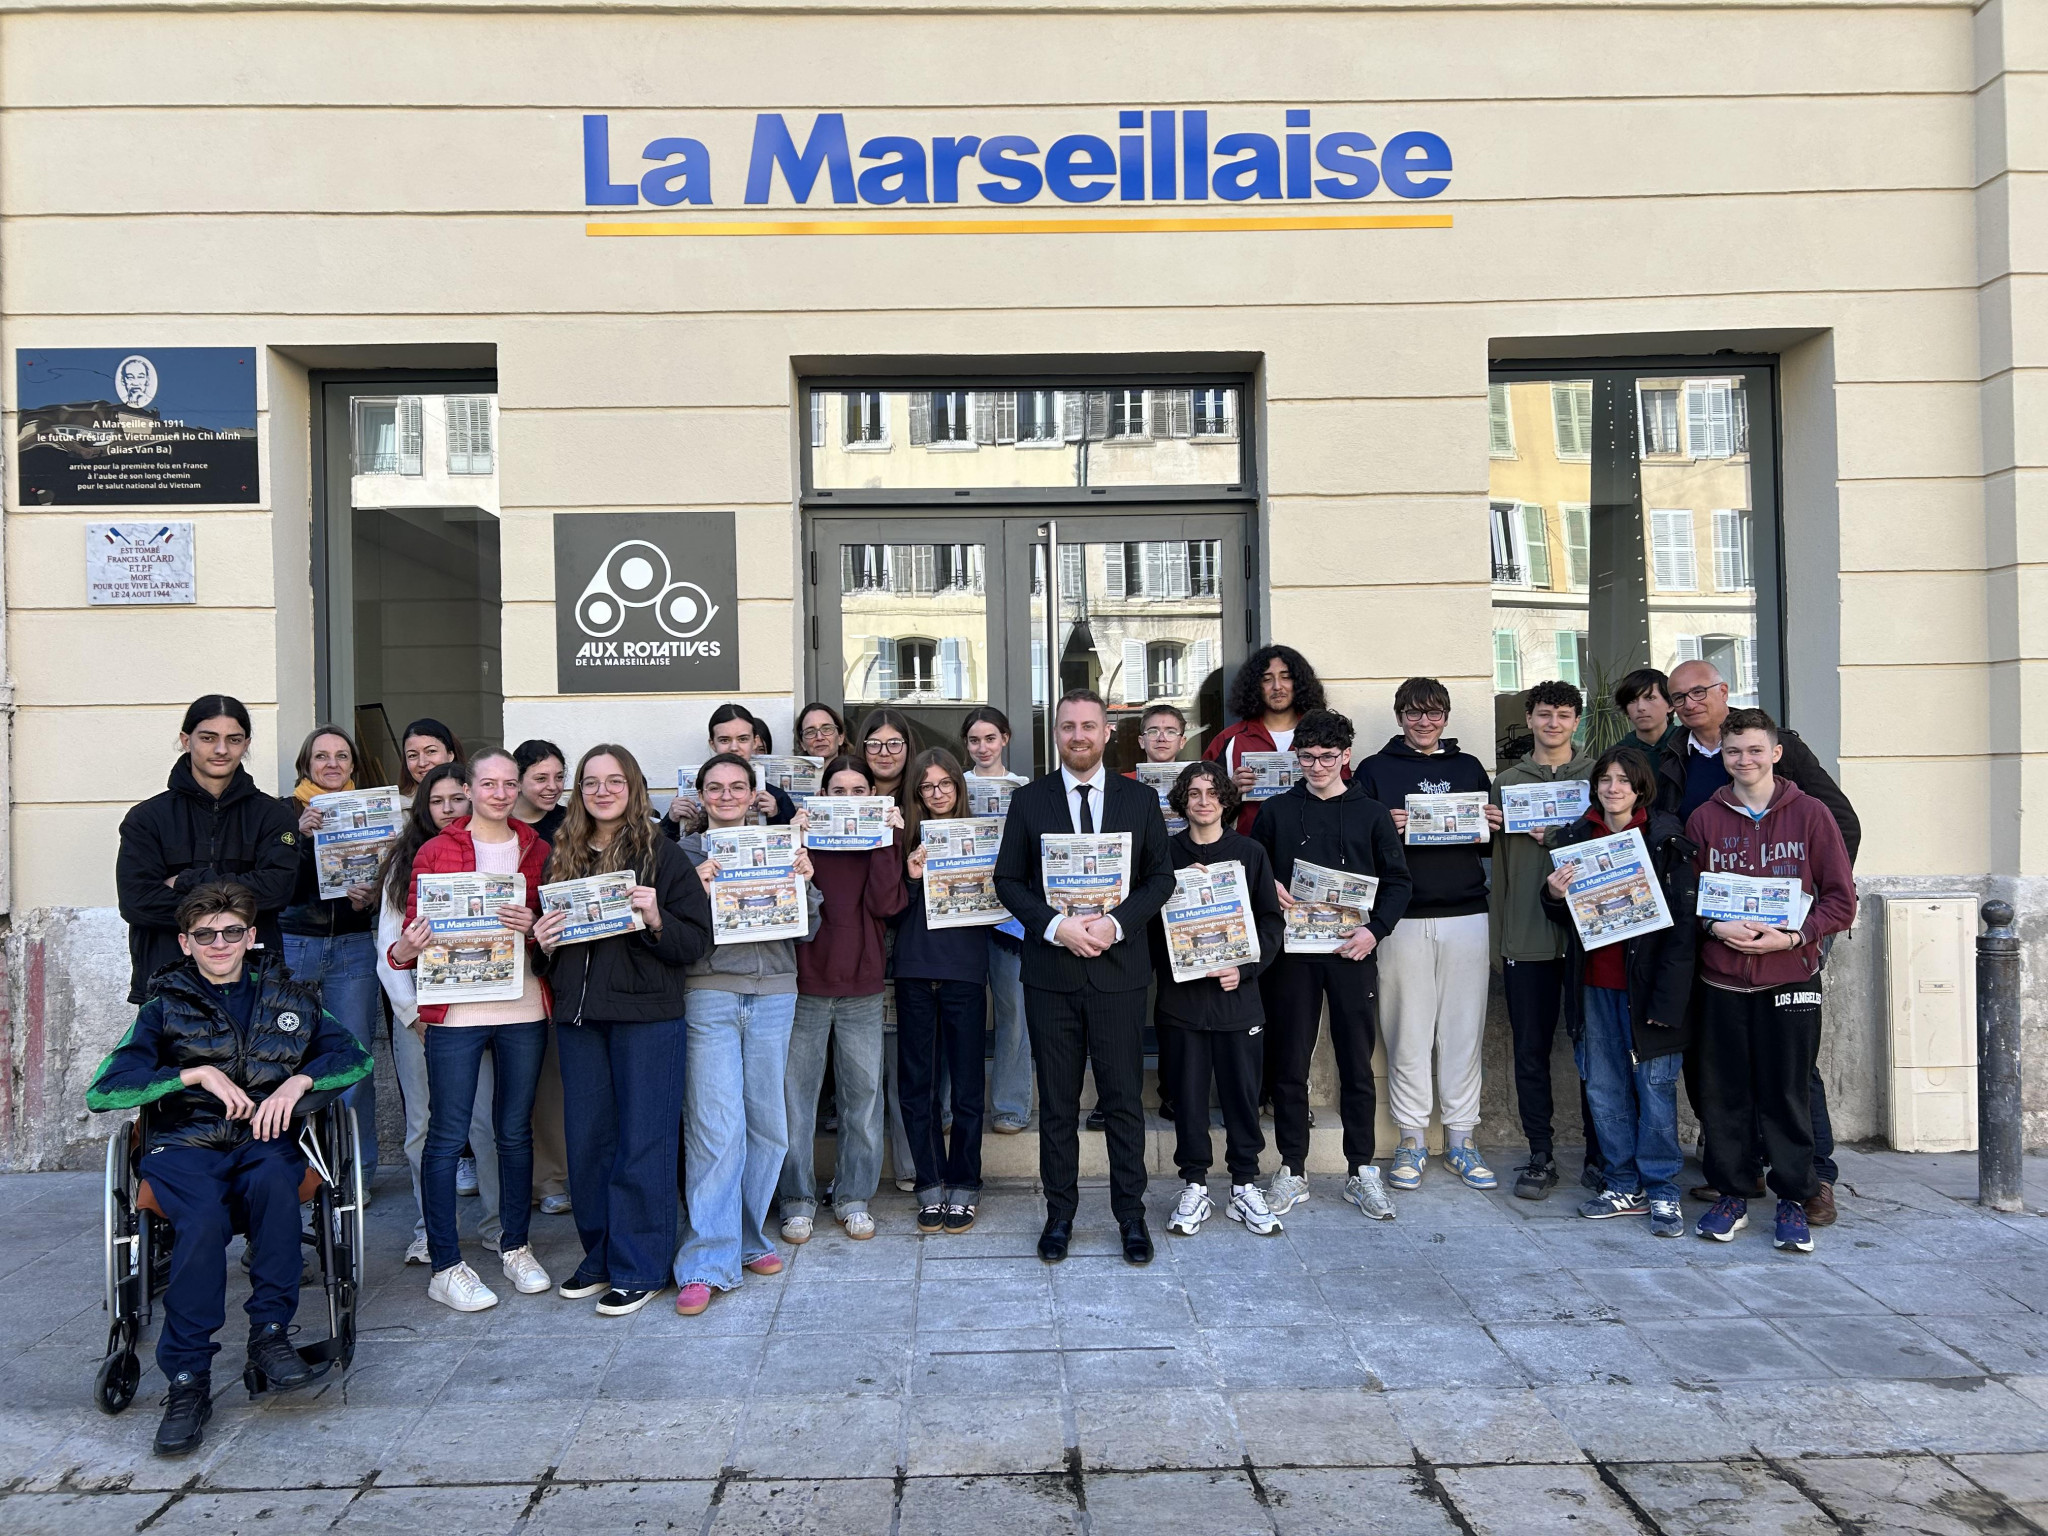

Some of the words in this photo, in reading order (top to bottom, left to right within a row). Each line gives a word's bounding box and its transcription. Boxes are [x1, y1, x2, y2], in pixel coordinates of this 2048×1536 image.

[583, 114, 713, 206] La
[744, 109, 1454, 206] Marseillaise
[92, 420, 100, 428] A
[102, 420, 146, 428] Marseille
[148, 420, 161, 428] en
[163, 420, 184, 428] 1911
[37, 433, 47, 442] le
[48, 433, 73, 442] futur
[76, 432, 122, 442] Président
[124, 432, 180, 441] Vietnamien
[182, 432, 196, 440] Ho
[198, 432, 214, 440] Chi
[216, 432, 240, 440] Minh
[106, 445, 133, 456] (alias
[135, 446, 154, 454] Van
[156, 444, 172, 455] Ba)
[92, 464, 111, 472] pour
[112, 462, 120, 470] la
[120, 462, 155, 472] première
[156, 462, 170, 470] fois
[87, 472, 92, 480] à
[94, 472, 117, 480] l'aube
[118, 472, 128, 480] de
[144, 472, 162, 480] long
[77, 483, 96, 491] pour
[96, 482, 104, 490] le
[105, 482, 124, 490] salut
[134, 546, 160, 554] TOMBÉ
[140, 554, 174, 562] AICARD
[114, 582, 130, 590] QUE
[130, 582, 148, 590] VIVE
[153, 590, 170, 598] 1944
[576, 641, 619, 658] AUX
[623, 641, 721, 658] ROTATIVES
[575, 658, 588, 666] DE
[590, 658, 602, 666] LA
[604, 657, 671, 666] MARSEILLAISE
[337, 828, 386, 840] Marseillaise
[946, 857, 992, 867] Marseillaise
[1709, 847, 1747, 872] PEPE
[734, 868, 786, 878] Marseillaise
[1066, 876, 1114, 884] Marseillaise
[1576, 882, 1586, 890] La
[1586, 867, 1634, 886] Marseillaise
[1186, 904, 1234, 918] Marseillaise
[1722, 912, 1778, 922] Marseillaise
[434, 922, 445, 930] La
[562, 930, 572, 938] La
[573, 921, 624, 936] Marseillaise
[1774, 993, 1792, 1007] LOS
